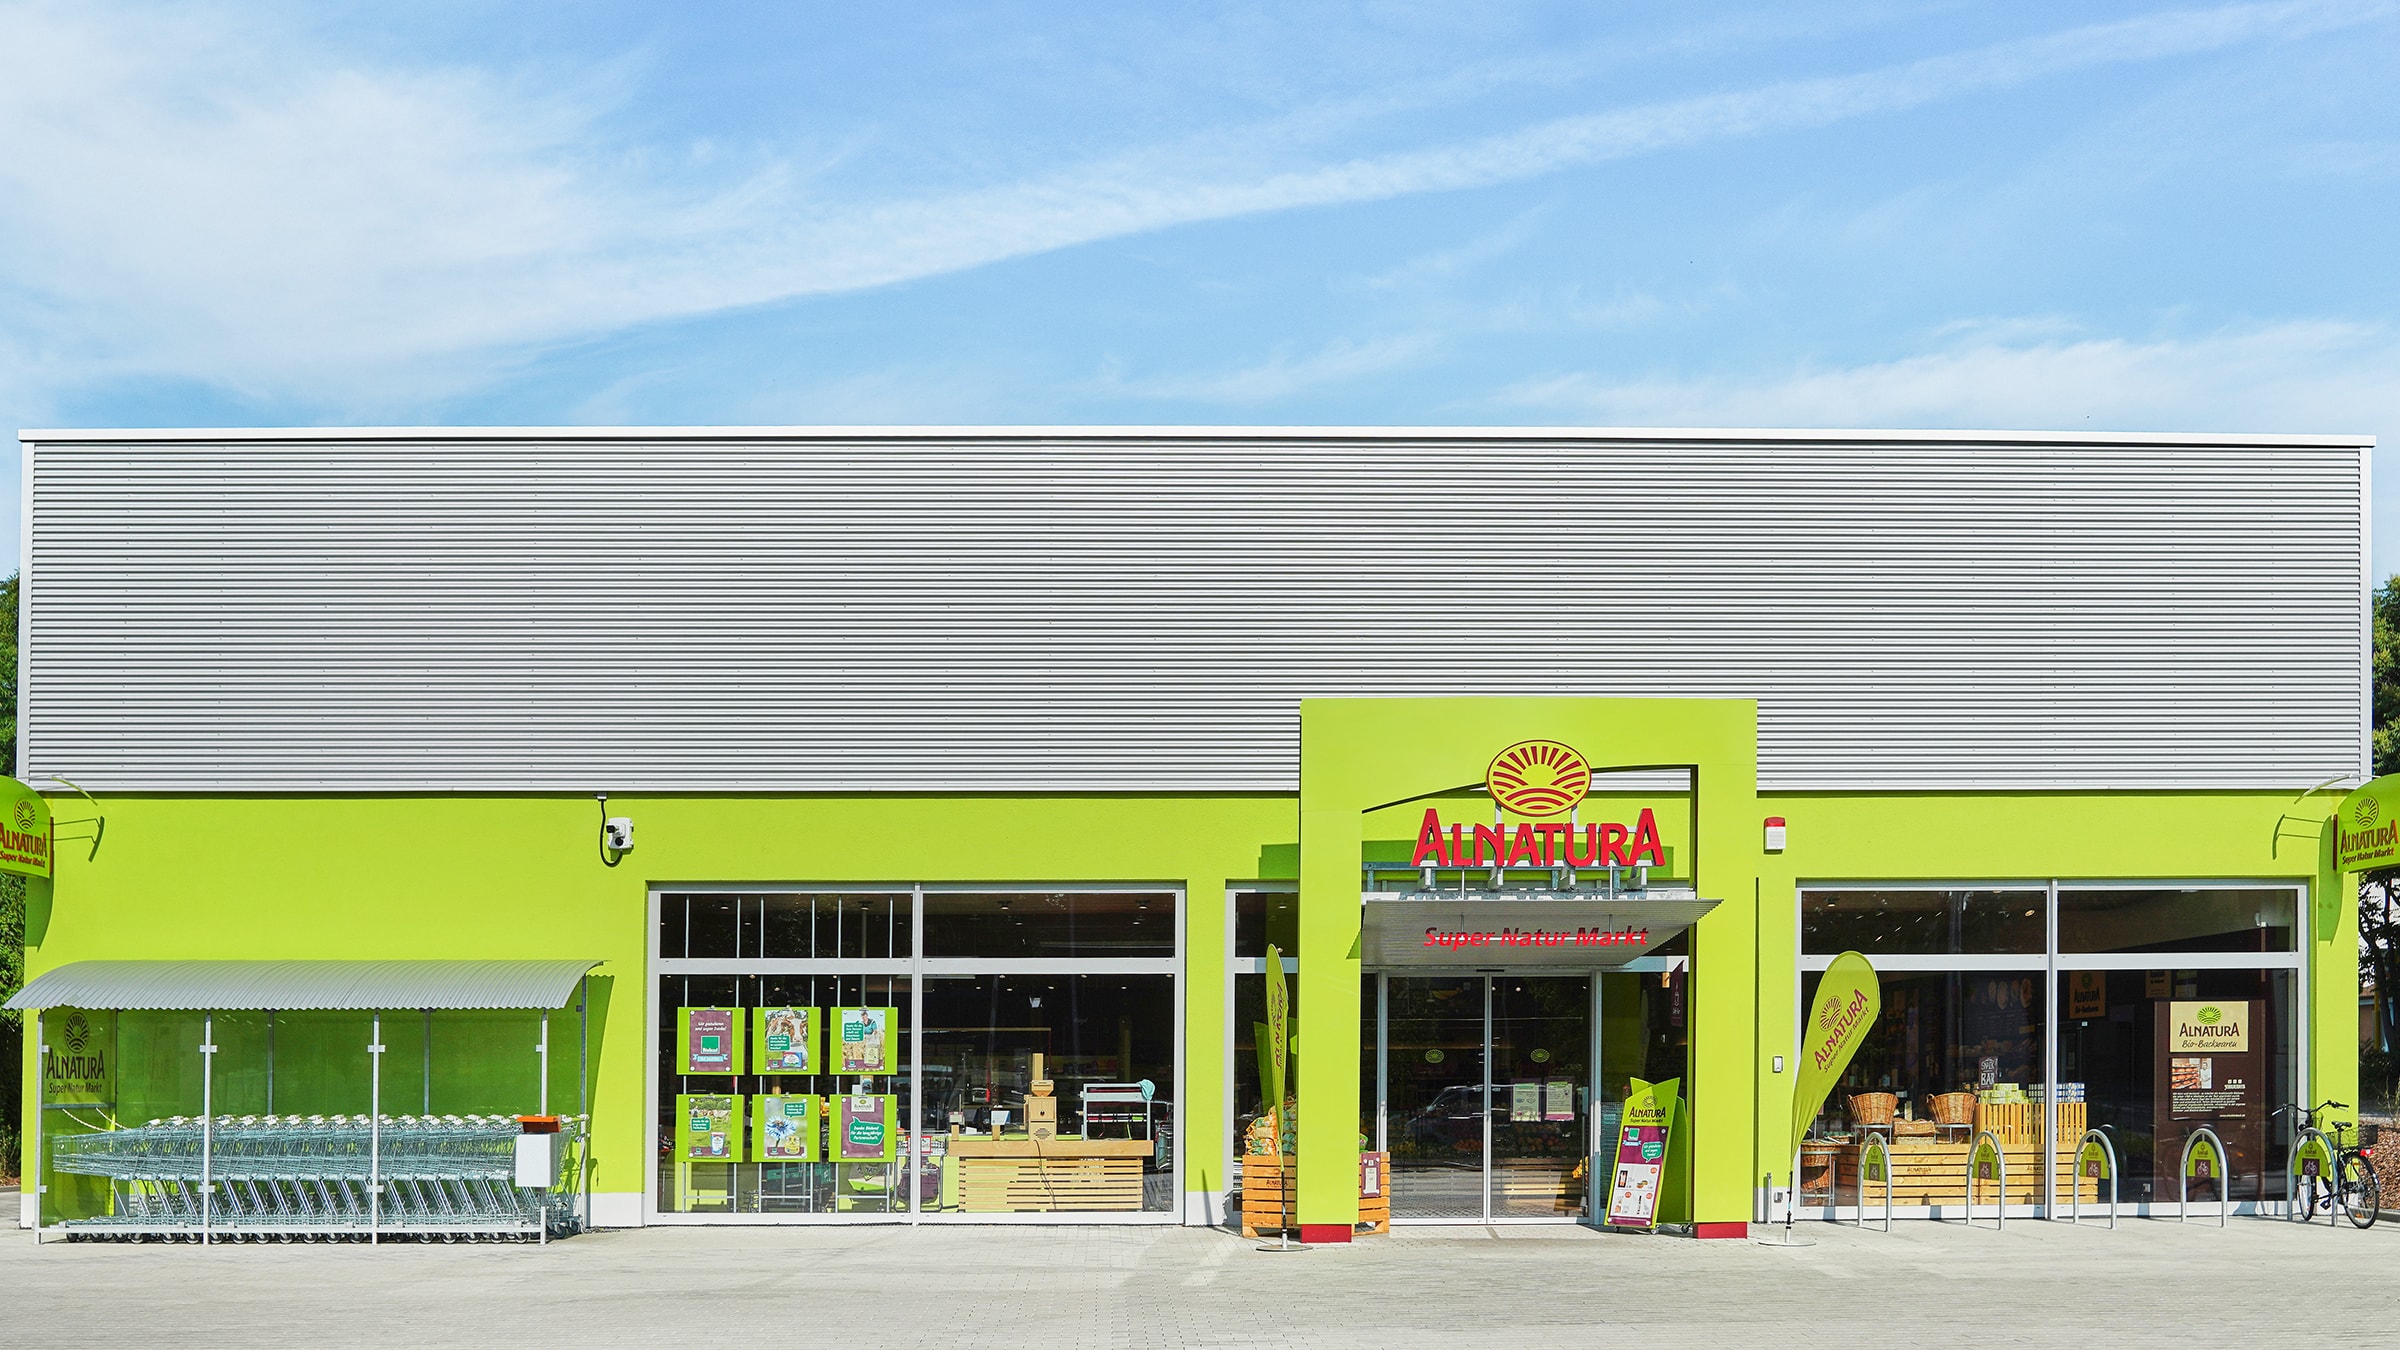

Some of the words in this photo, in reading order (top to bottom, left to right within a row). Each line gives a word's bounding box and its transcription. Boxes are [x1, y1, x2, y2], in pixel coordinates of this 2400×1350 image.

[1410, 807, 1666, 867] ALNATURA
[2340, 818, 2399, 855] ALNATURA
[1423, 927, 1495, 952] Super
[1501, 927, 1571, 948] Natur
[1575, 925, 1649, 947] Markt
[1814, 988, 1869, 1071] ALNATURA
[2179, 1022, 2240, 1038] ALNATURA
[2181, 1039, 2237, 1049] Bio-Backwaren
[46, 1048, 106, 1080] ALNATURA
[48, 1082, 67, 1096] Super
[85, 1082, 102, 1094] Markt
[1981, 1072, 1995, 1086] BAR
[1629, 1106, 1666, 1118] ALNATURA
